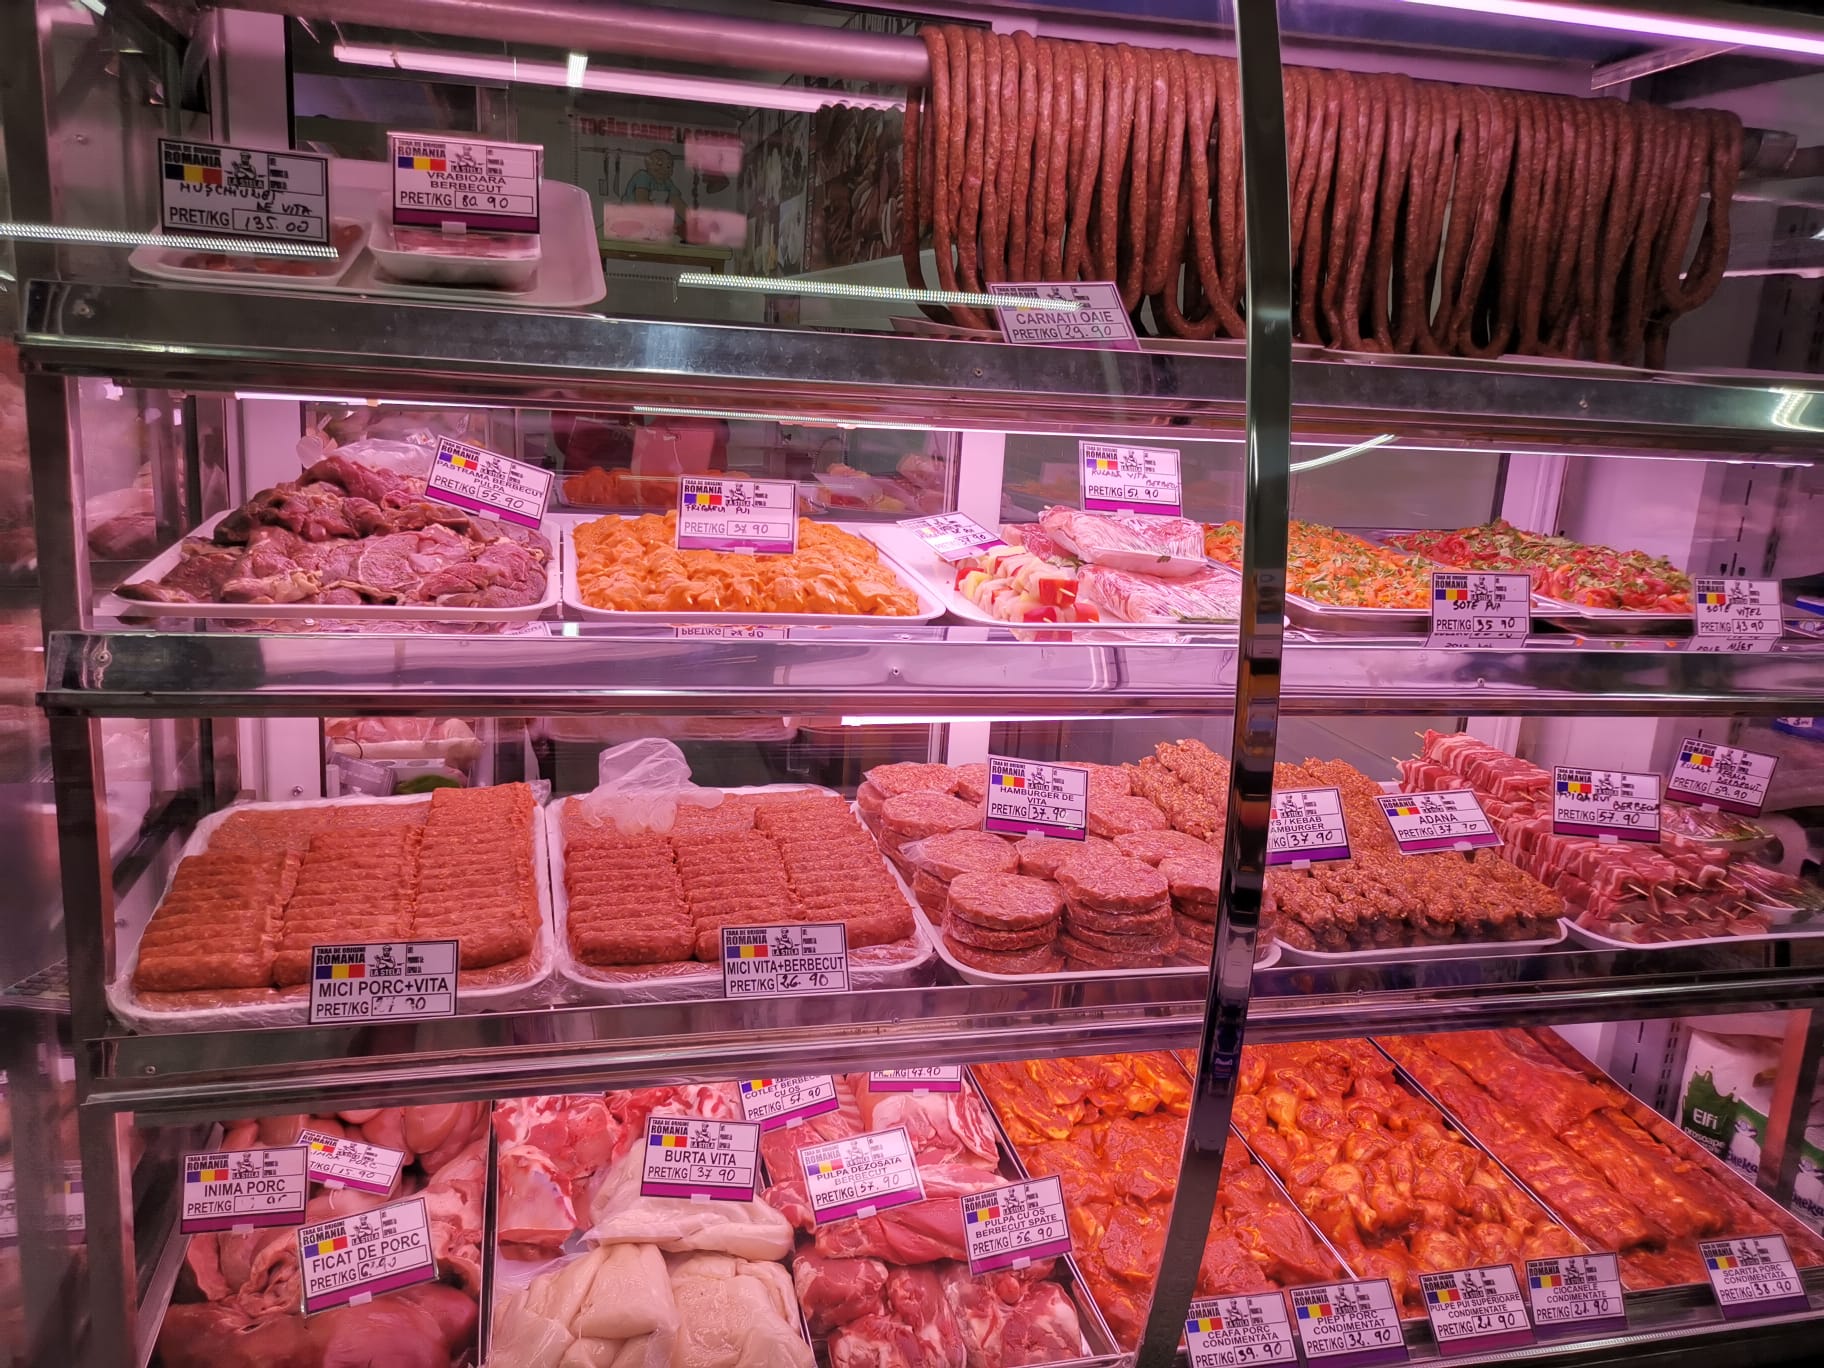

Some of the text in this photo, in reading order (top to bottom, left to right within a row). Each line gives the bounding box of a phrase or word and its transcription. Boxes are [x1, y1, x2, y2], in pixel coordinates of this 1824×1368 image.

[398, 146, 446, 158] ROMANIA
[427, 171, 506, 184] VRABIOARA
[430, 181, 503, 192] BERBECUT
[400, 191, 509, 208] PRET/KG 90
[169, 207, 230, 226] PRET/KG
[1016, 311, 1113, 324] CARNATI OAIE
[1013, 328, 1058, 339] PRET/KG
[441, 445, 479, 462] ROMANIA
[1086, 451, 1118, 460] ROMANIA
[434, 475, 476, 495] PRET/KG
[437, 461, 543, 498] PASTRAMA BERBECUT
[474, 477, 505, 493] PULPA
[684, 485, 722, 494] ROMANIA
[1089, 485, 1158, 498] PRET/KG 90
[684, 522, 769, 534] PRET/KG 90
[1436, 620, 1471, 630] PRET/KG
[1700, 622, 1731, 632] PRET/KG
[992, 766, 1025, 776] ROMANIA
[1557, 774, 1592, 783] ROMANIA
[1674, 777, 1707, 791] PRET/KG
[1000, 786, 1060, 800] HAMBURGER
[1027, 797, 1047, 805] VITA
[991, 803, 1027, 816] PRET/KG
[1558, 809, 1595, 821] PRET/KG
[1419, 813, 1458, 824] ADANA
[1270, 823, 1324, 833] AMBURGER
[1398, 827, 1434, 838] PRET/KG
[726, 935, 768, 945] ROMANIA
[316, 953, 365, 965] ROMANIA
[727, 957, 844, 975] MICI VITA+BERBECUT
[319, 977, 449, 998] MICI PORC+VITA
[730, 978, 775, 992] PRET/KG
[316, 1001, 369, 1016] PRET/KG
[745, 1085, 778, 1099] COTLET
[788, 1086, 800, 1094] OS
[748, 1101, 781, 1118] PRET/KG
[1693, 1108, 1718, 1130] Elfi
[651, 1125, 688, 1135] ROMANIA
[302, 1134, 337, 1146] ROMANIA
[665, 1150, 736, 1166] BURTA VITA
[804, 1150, 841, 1165] ROMANIA
[187, 1160, 229, 1171] ROMANIA
[648, 1166, 688, 1178] PRET/KG
[817, 1157, 902, 1181] PULPA DEZOSATA
[834, 1167, 888, 1186] BERBECUT
[204, 1179, 286, 1197] INIMA PORC
[815, 1187, 855, 1204] PRET/KG
[187, 1200, 232, 1214] PRET/KG
[965, 1197, 998, 1212] ROMANIA
[985, 1208, 1046, 1228] PULPA CU OS
[976, 1213, 1057, 1239] BERBECUT SPATE
[302, 1227, 346, 1245] ROMANIA
[973, 1236, 1009, 1254] PRET/KG
[312, 1250, 352, 1273] FICAT
[358, 1244, 377, 1260] DE
[381, 1232, 420, 1254] PORC
[1703, 1248, 1733, 1257] ROMANIA
[1529, 1266, 1560, 1276] ROMANIA
[1722, 1264, 1782, 1277] SCARITA PORC
[310, 1269, 357, 1291] PRET/KG
[1724, 1271, 1787, 1285] CONDIMENTATA
[1424, 1280, 1457, 1292] ROMANIA
[1553, 1284, 1599, 1294] CIOCANELE
[1295, 1294, 1329, 1306] ROMANIA
[1547, 1290, 1607, 1303] CONDIMENTATE
[1720, 1286, 1753, 1301] PRET/KG
[1430, 1293, 1520, 1312] PULPE PUI SUPERIOARE
[1317, 1310, 1378, 1325] PIEPT PORC
[1448, 1304, 1508, 1318] CONDIMENTATE
[1537, 1305, 1570, 1320] PRET/KG
[1208, 1325, 1270, 1339] CEAFA PORC
[1313, 1319, 1385, 1335] CONDIMENTAT
[1437, 1320, 1473, 1336] PRET/KG
[1202, 1332, 1279, 1348] CONDIMENTATA
[1307, 1337, 1344, 1352] PRET/KG
[1196, 1351, 1234, 1367] PRET/KG
